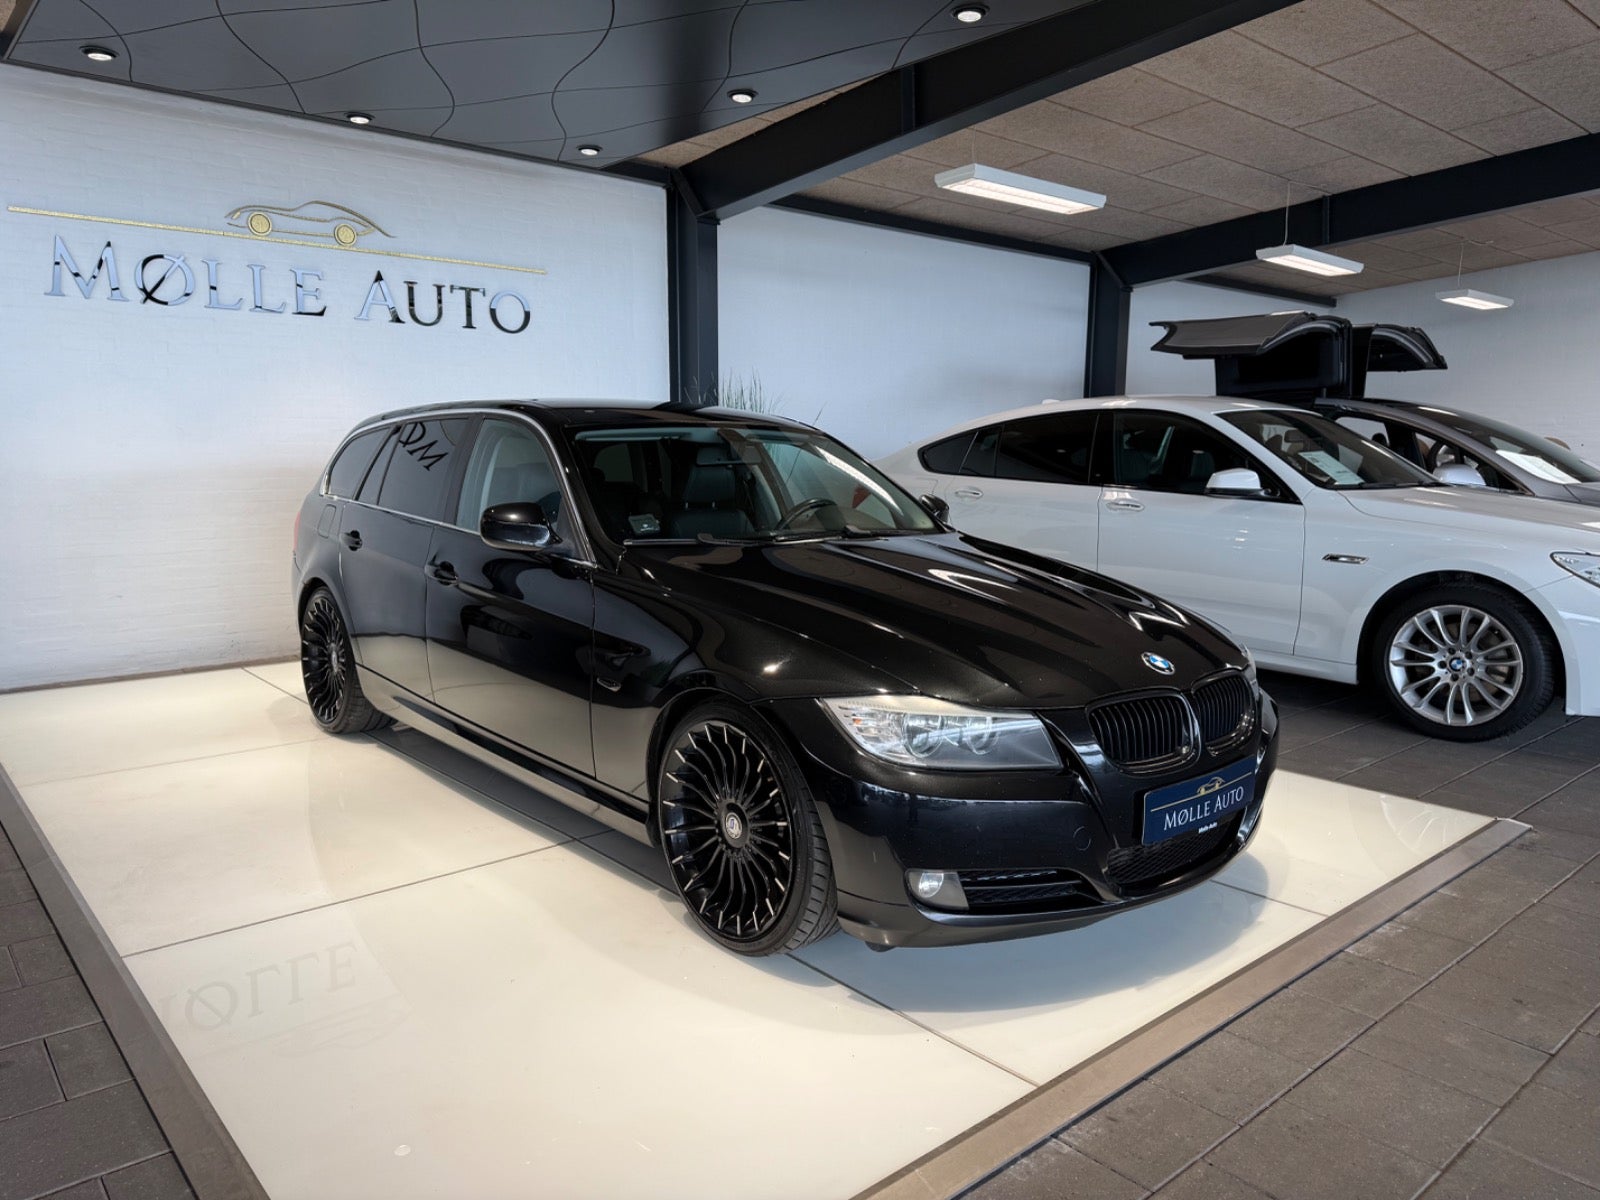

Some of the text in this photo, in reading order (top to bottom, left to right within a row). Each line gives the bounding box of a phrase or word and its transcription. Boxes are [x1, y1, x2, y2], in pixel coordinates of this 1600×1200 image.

[44, 233, 531, 334] MØLLE AUTO
[1163, 801, 1211, 831] MØLLE
[1214, 786, 1244, 813] AUTO
